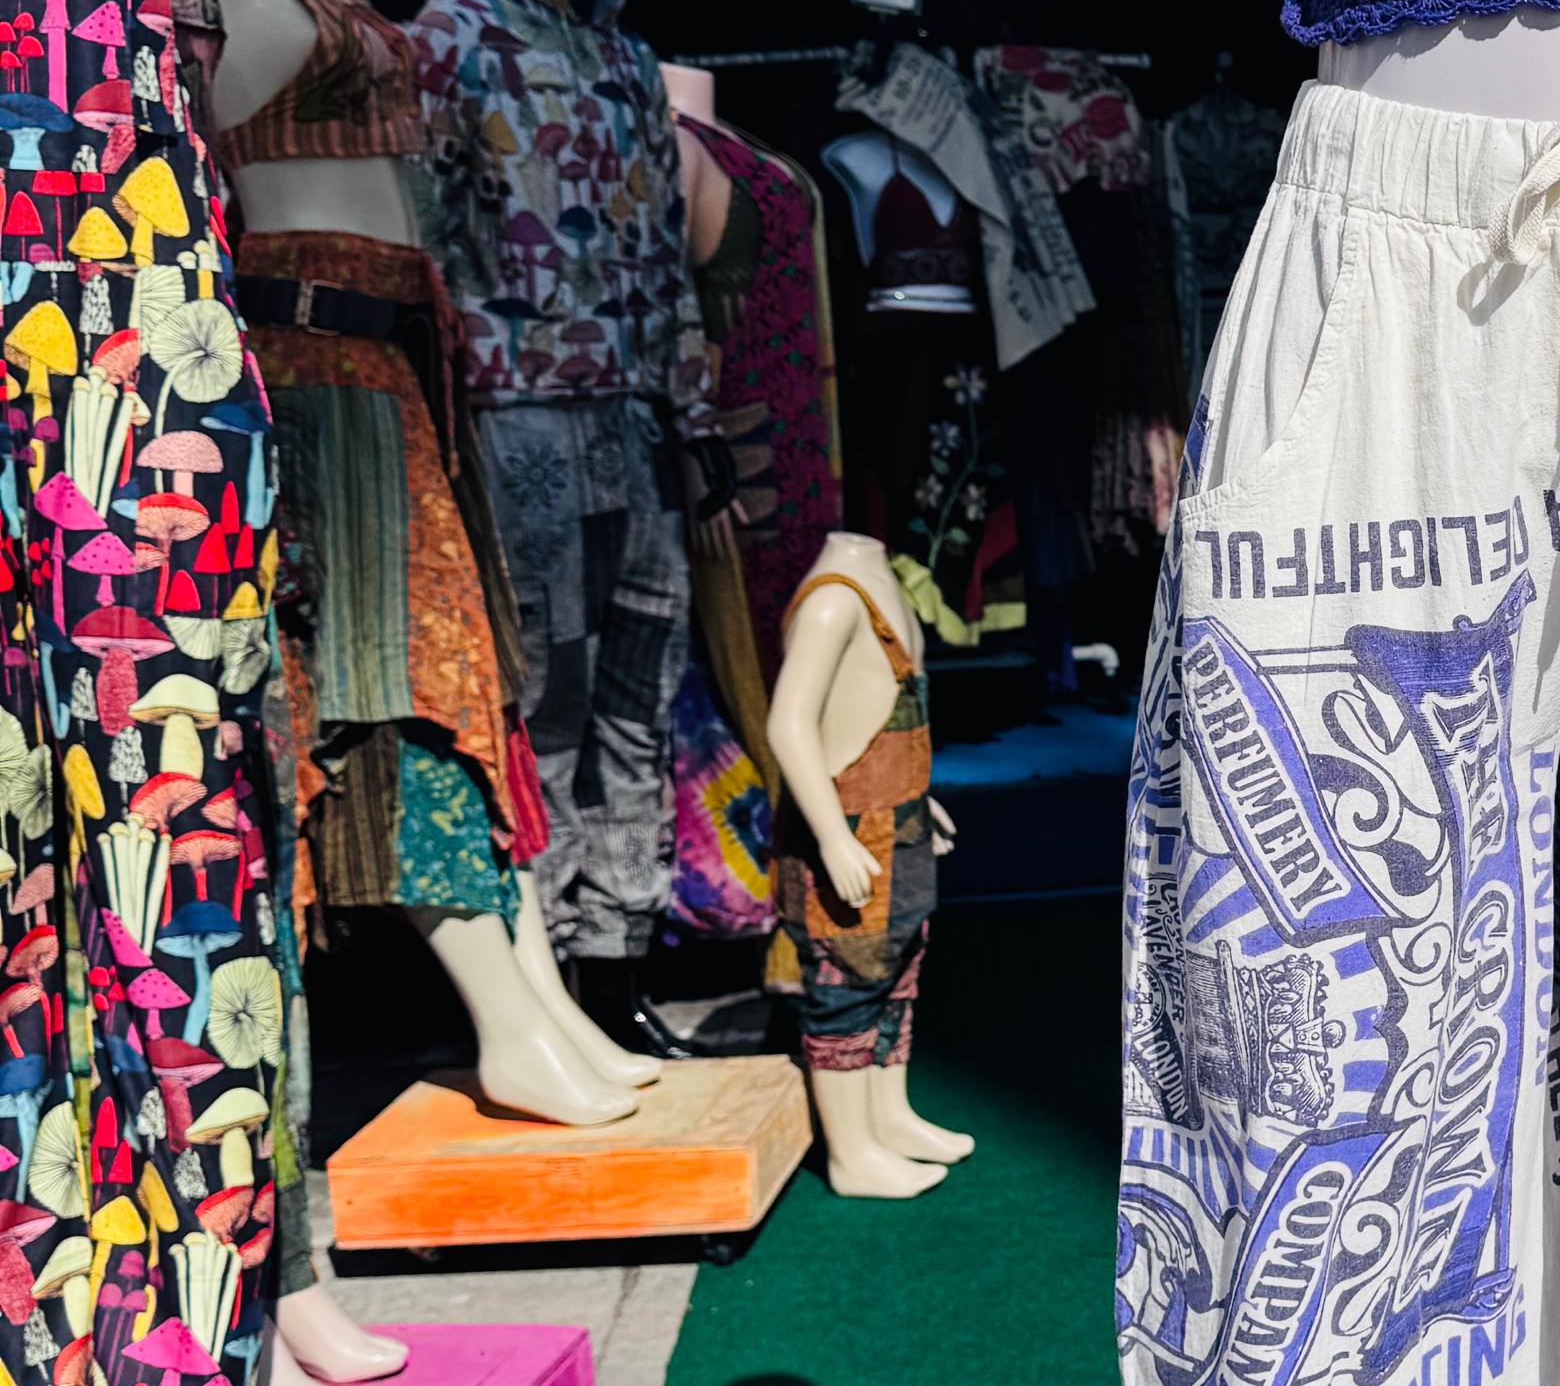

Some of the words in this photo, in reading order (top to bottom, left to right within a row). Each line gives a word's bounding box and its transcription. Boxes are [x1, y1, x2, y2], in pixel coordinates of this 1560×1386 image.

[1195, 495, 1529, 598] DELIGHTFUL
[1184, 643, 1342, 911] PERFUMERY
[1400, 890, 1510, 1295] CROWN
